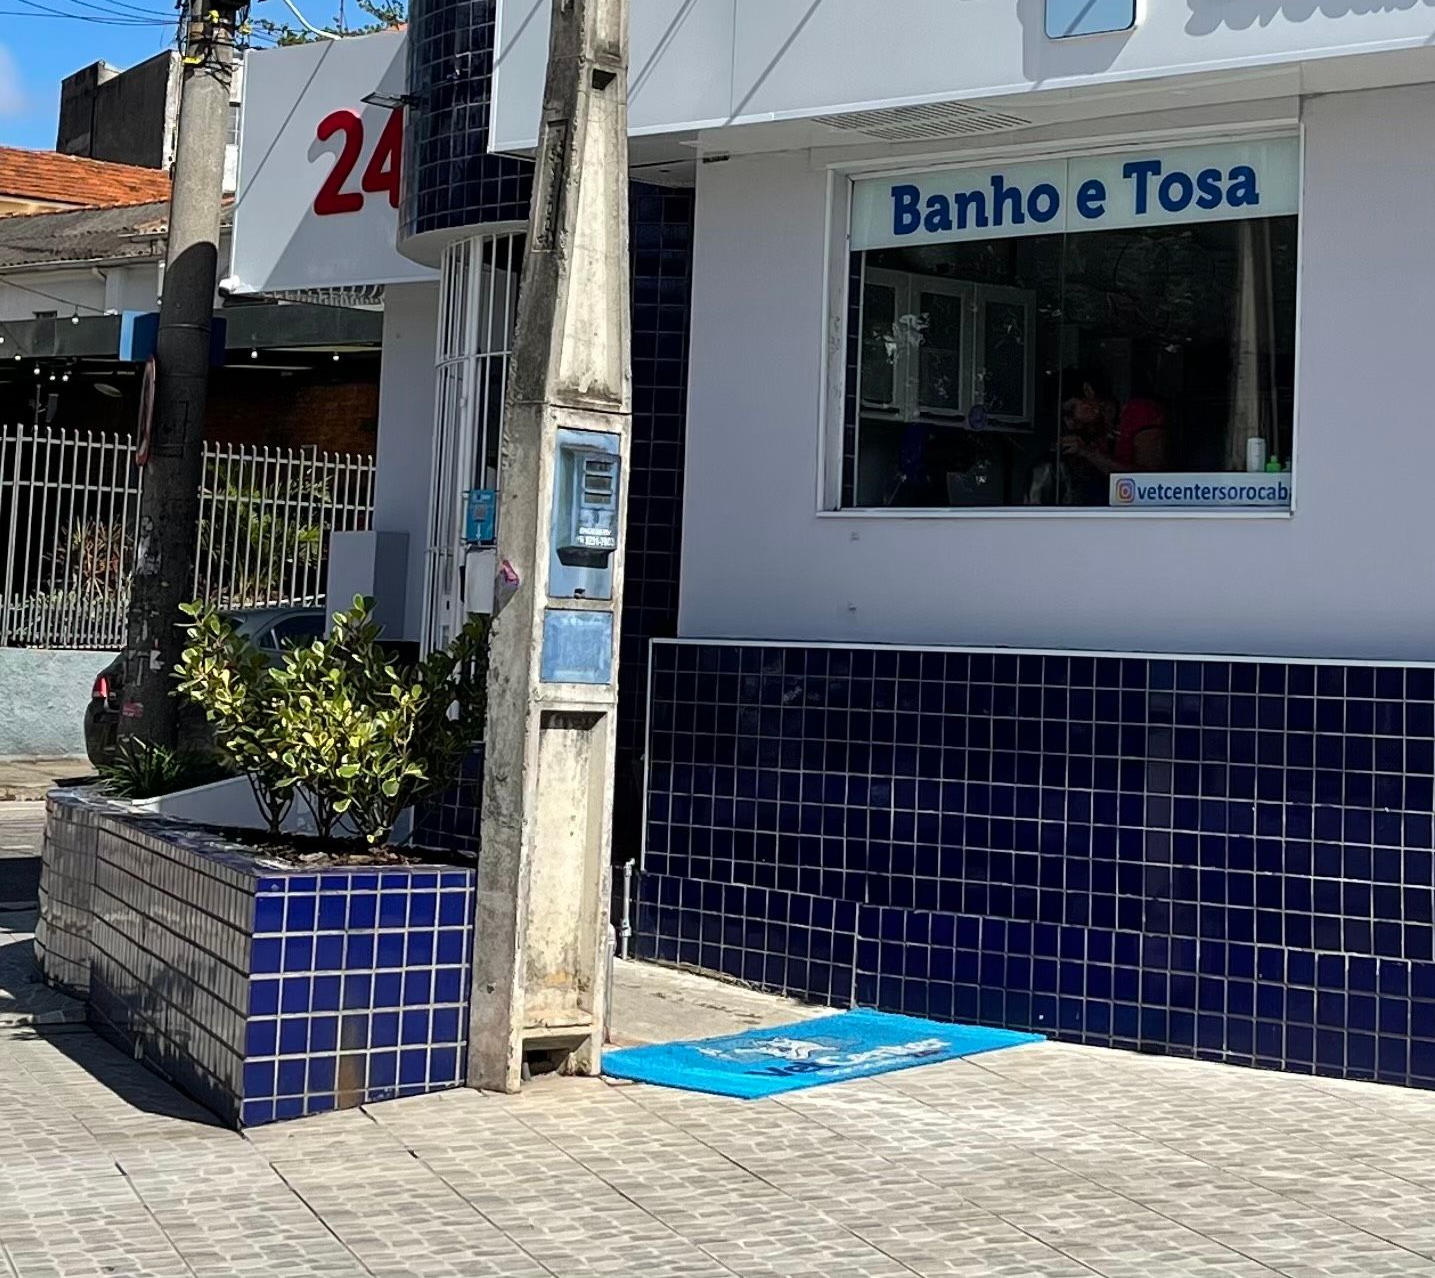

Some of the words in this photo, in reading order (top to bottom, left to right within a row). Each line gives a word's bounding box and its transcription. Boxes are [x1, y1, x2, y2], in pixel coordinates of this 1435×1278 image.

[891, 175, 1060, 236] Banho
[1076, 179, 1107, 220] e
[1122, 159, 1260, 215] Tosa
[1137, 482, 1291, 501] vetcentersorocab
